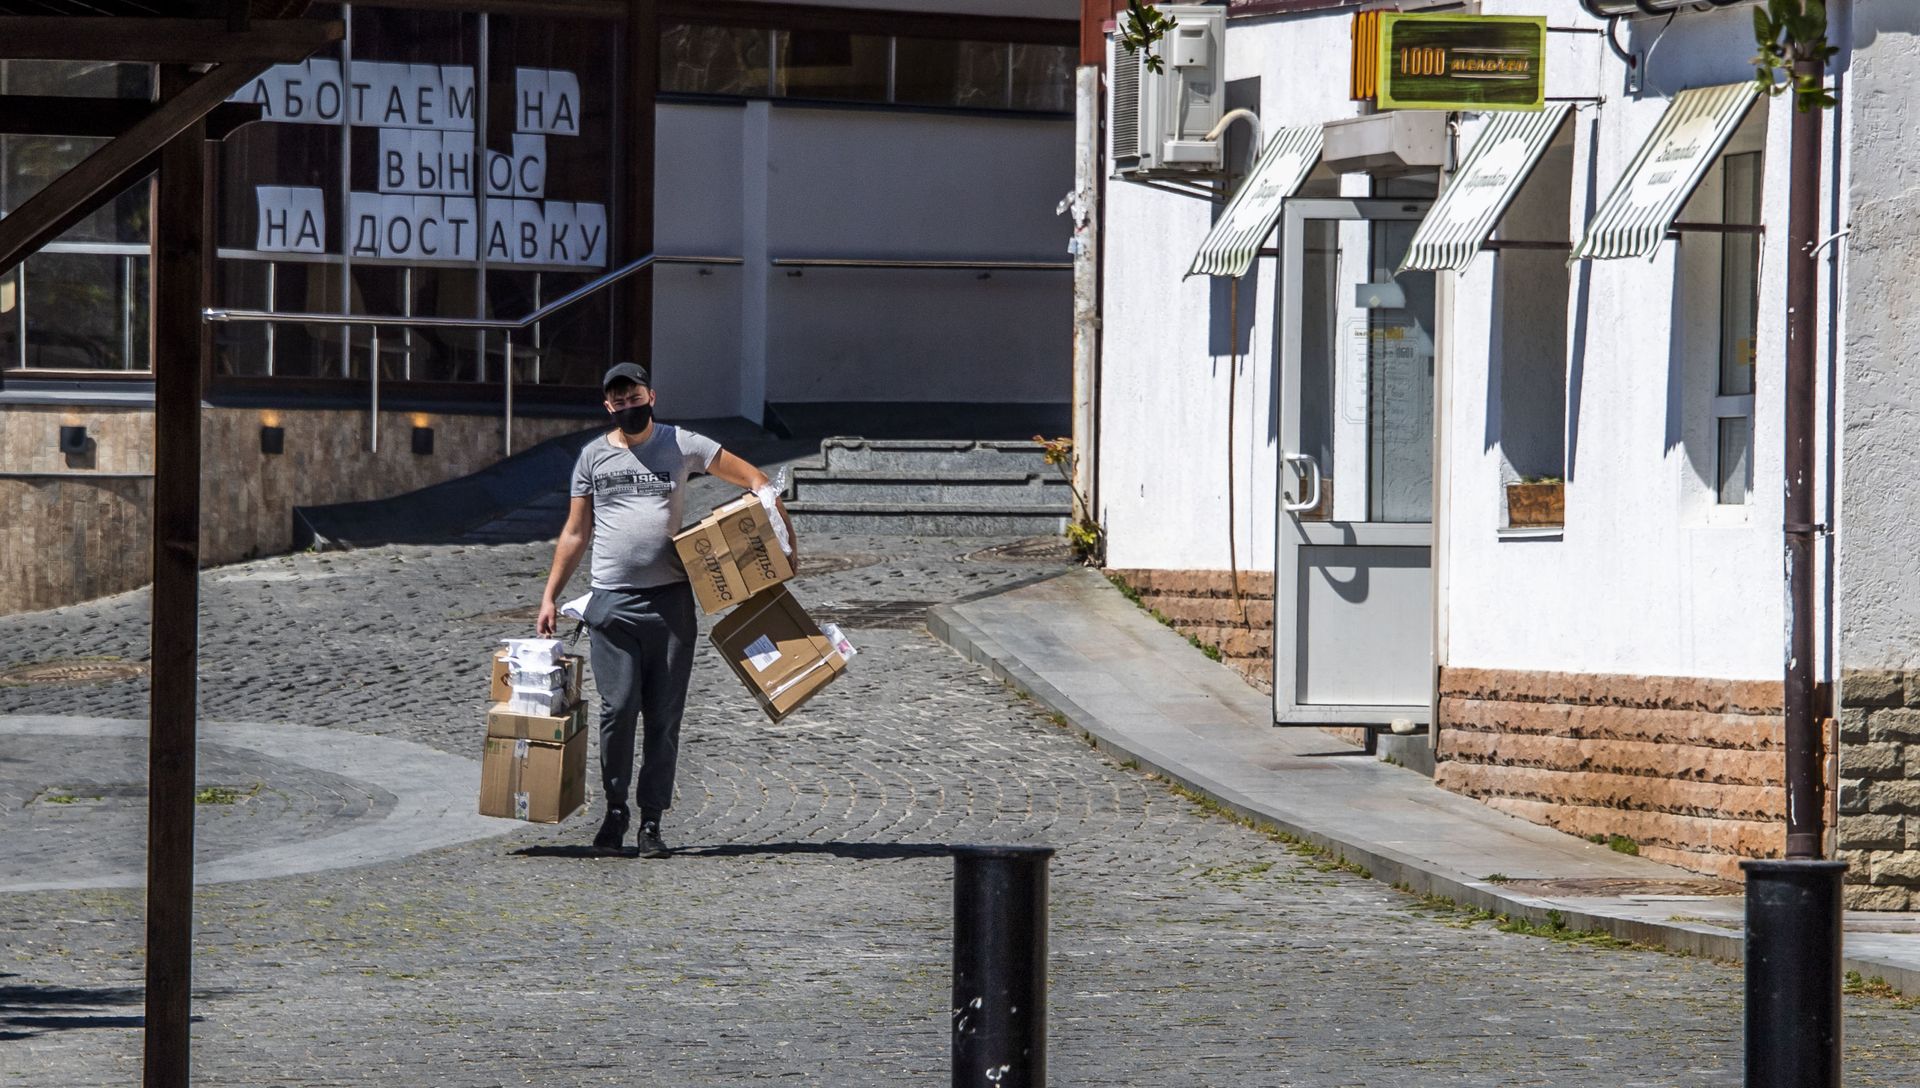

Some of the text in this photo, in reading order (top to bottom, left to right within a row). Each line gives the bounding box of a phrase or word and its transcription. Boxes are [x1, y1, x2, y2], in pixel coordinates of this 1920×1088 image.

[1401, 48, 1445, 75] 1000
[254, 78, 574, 130] АБОТАЕМ НА
[387, 150, 540, 193] ВЫНОС
[266, 208, 601, 261] НА ДОСТАВКУ
[705, 556, 733, 601] ПУЛЬС
[749, 535, 777, 580] ПУЛЬС
